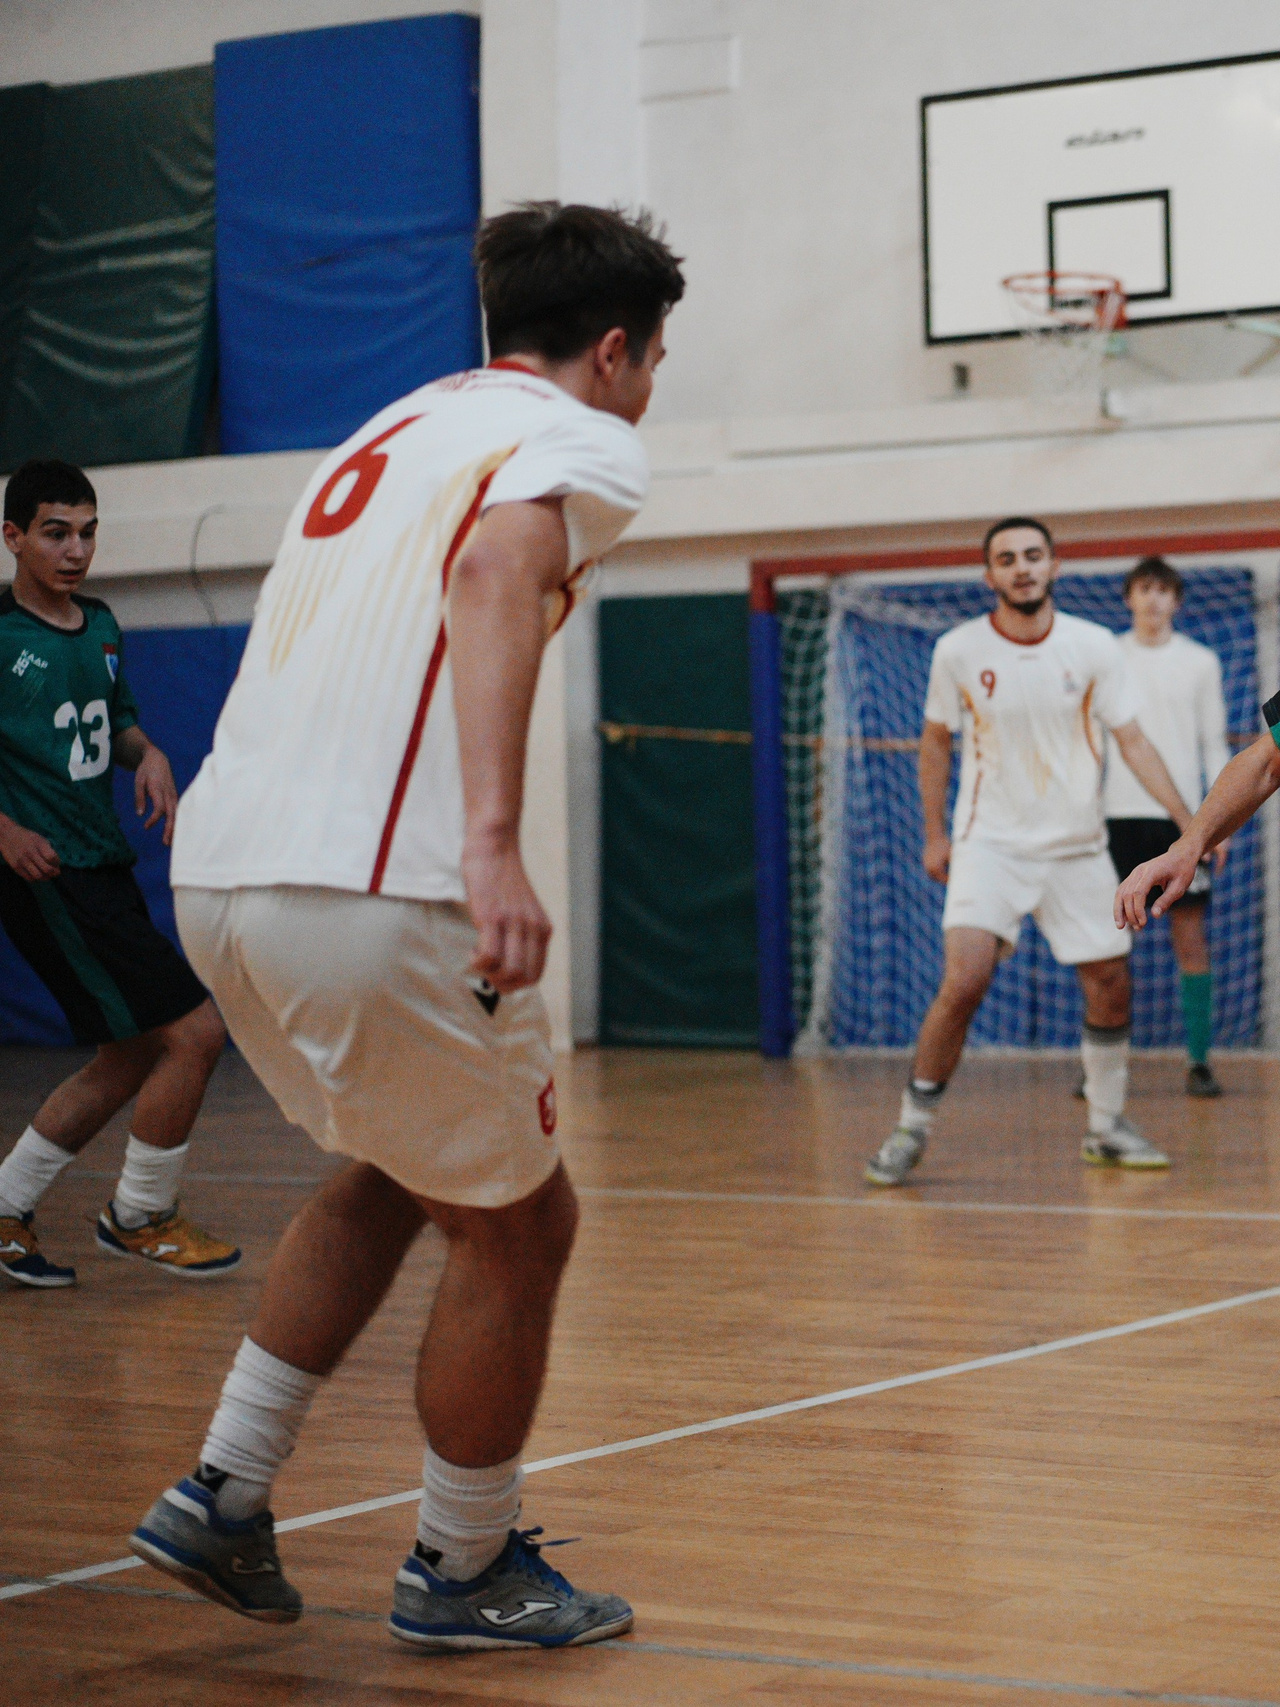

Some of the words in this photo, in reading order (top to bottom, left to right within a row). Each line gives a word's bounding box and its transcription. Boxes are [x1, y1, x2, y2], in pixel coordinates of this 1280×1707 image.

[302, 412, 429, 539] 6
[980, 669, 996, 699] 9
[54, 699, 111, 781] 23
